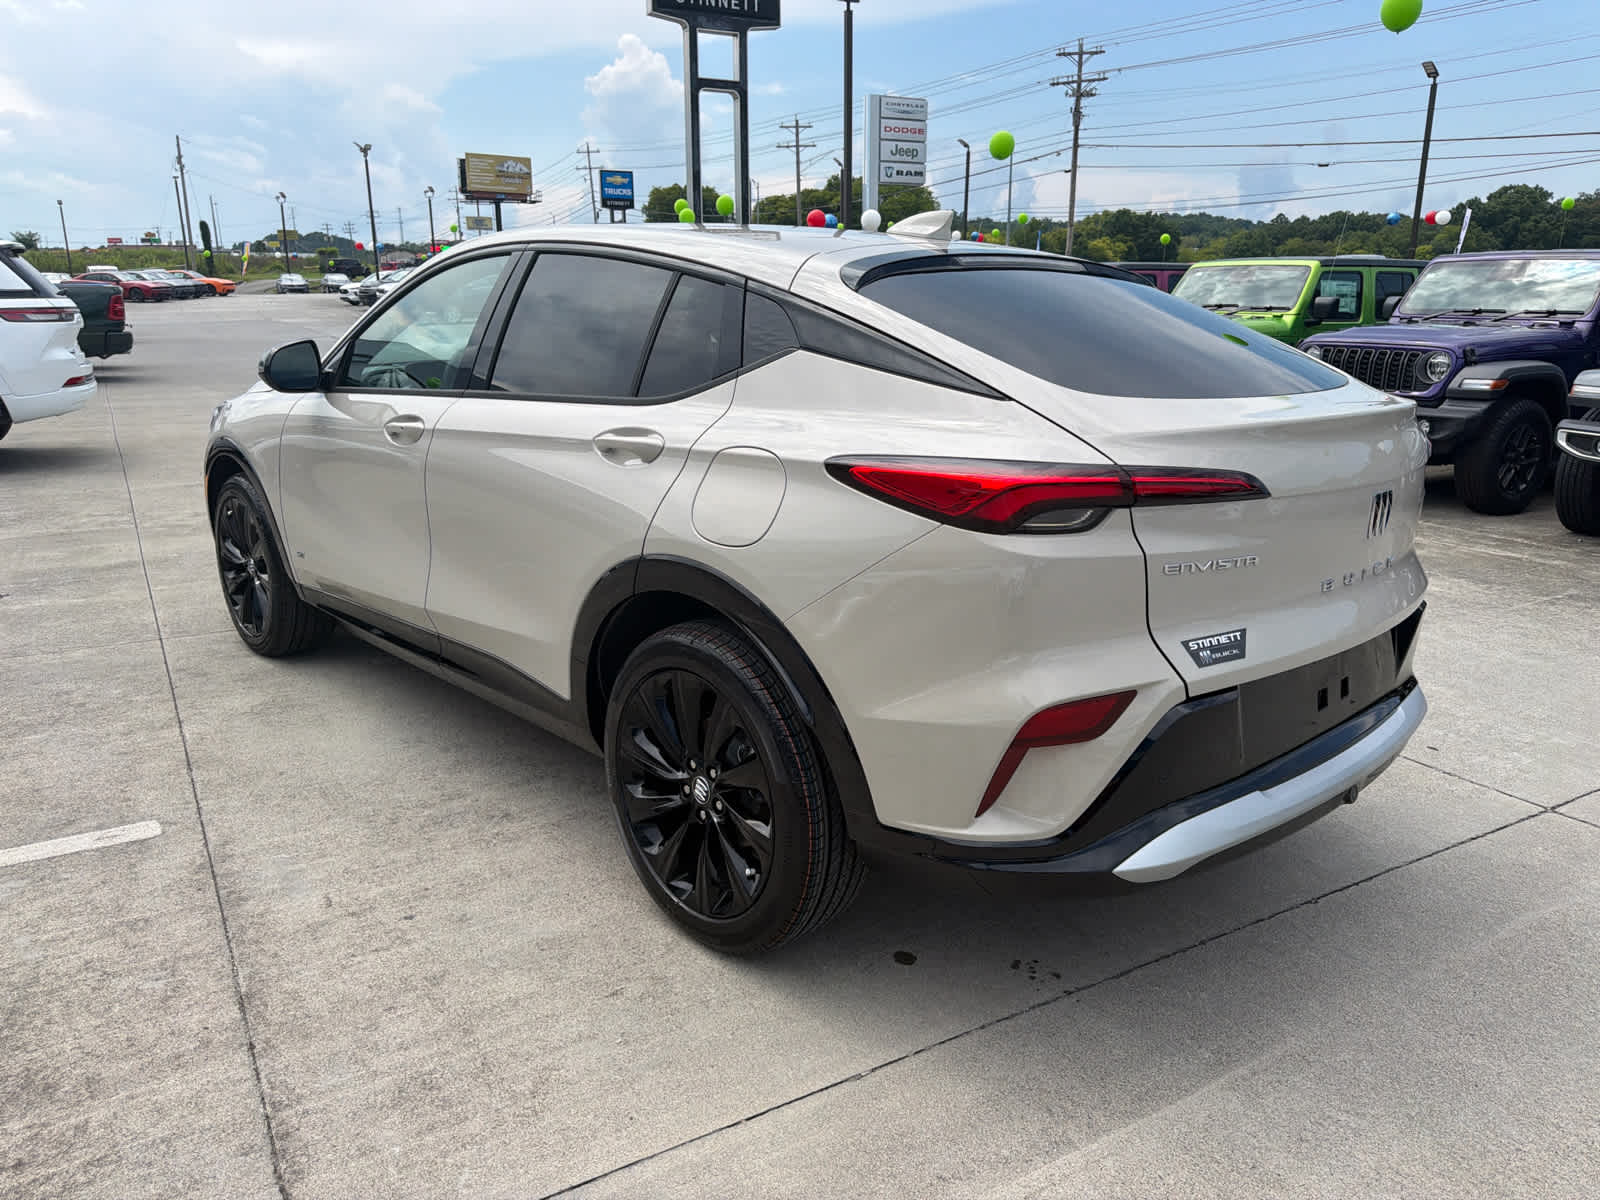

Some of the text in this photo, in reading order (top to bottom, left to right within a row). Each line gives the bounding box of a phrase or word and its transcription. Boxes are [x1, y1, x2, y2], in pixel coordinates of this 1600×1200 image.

[884, 126, 925, 135] DODGE
[890, 144, 919, 159] Jeep
[895, 169, 924, 177] RAM
[604, 187, 632, 196] TRUCKS
[1162, 555, 1259, 576] ENVISTA
[1188, 631, 1242, 651] STINNETT
